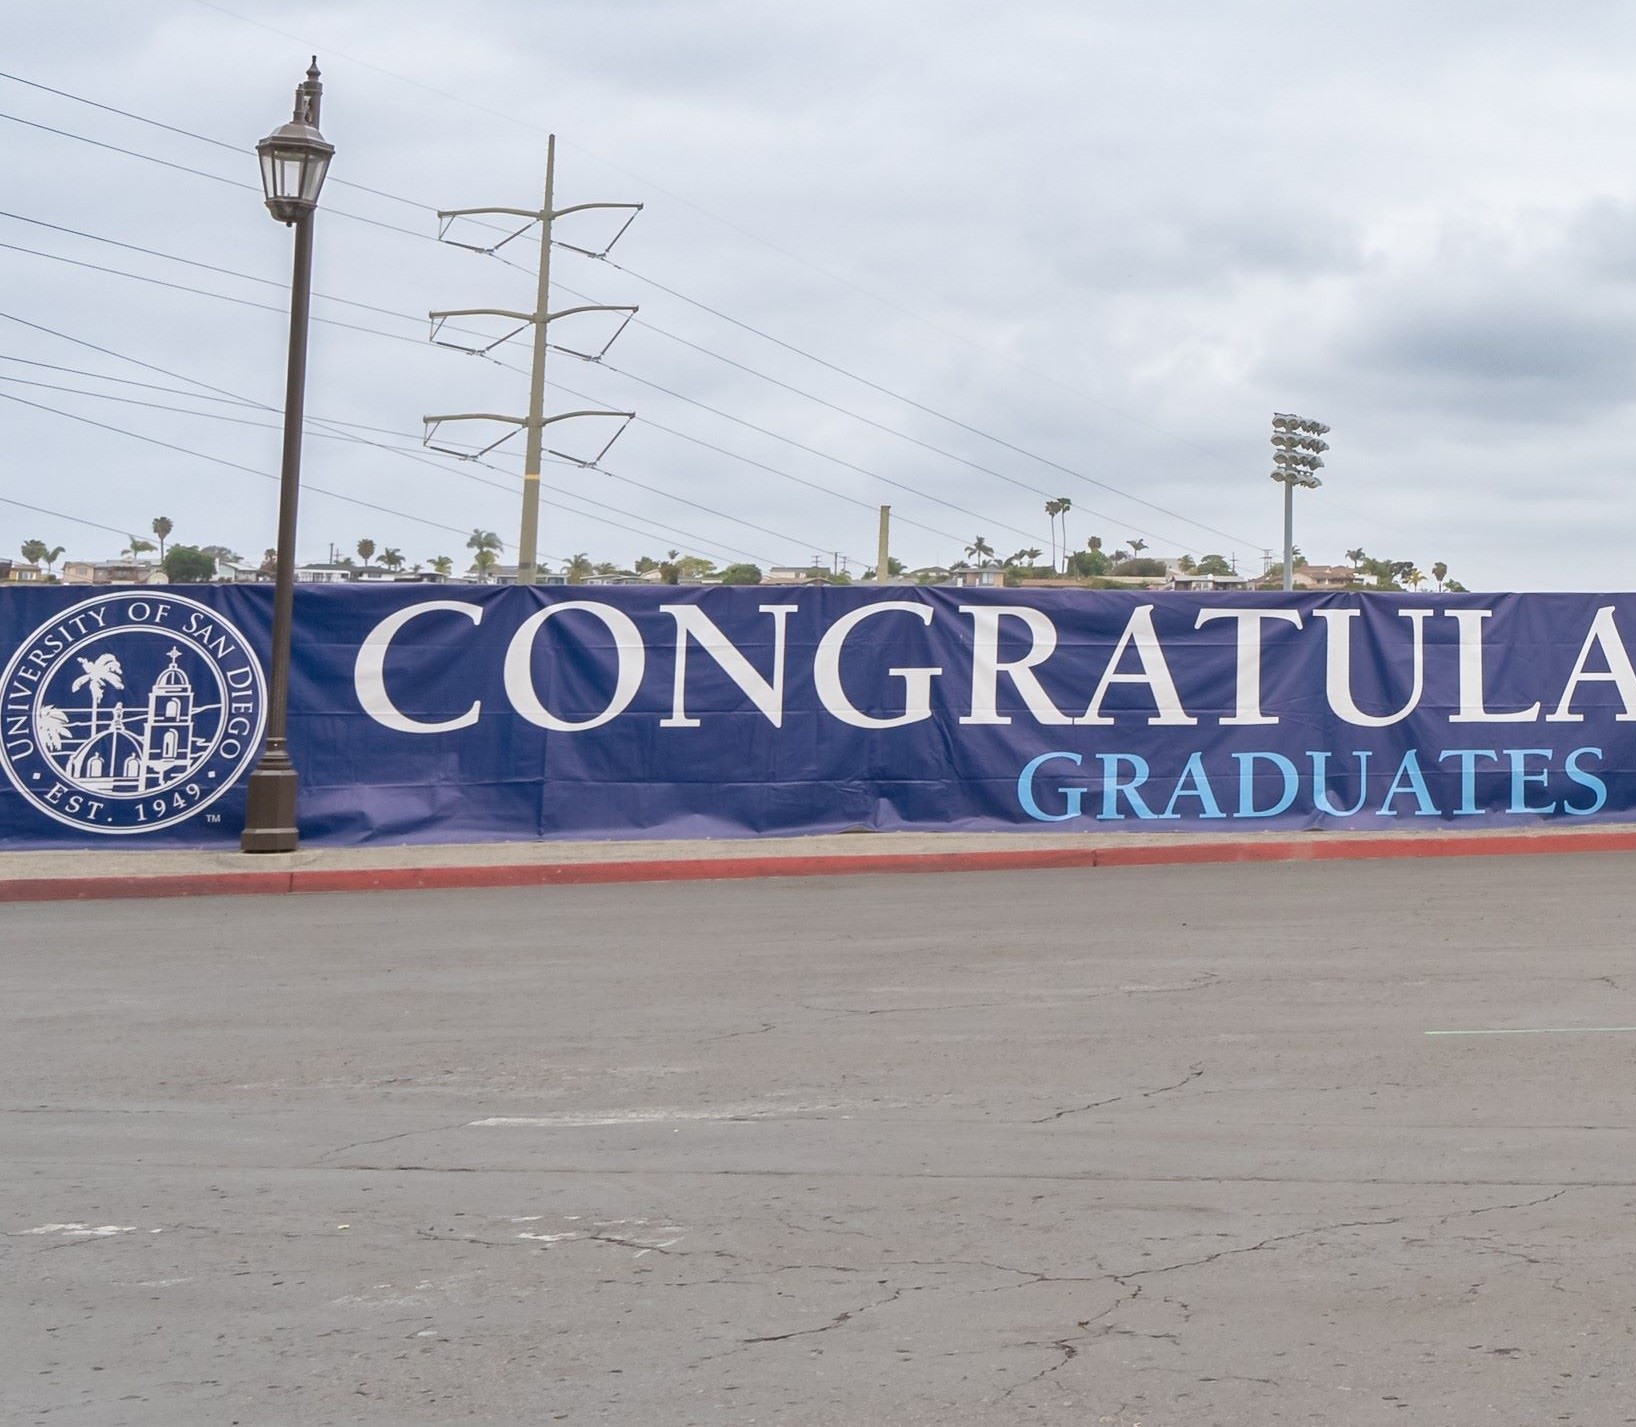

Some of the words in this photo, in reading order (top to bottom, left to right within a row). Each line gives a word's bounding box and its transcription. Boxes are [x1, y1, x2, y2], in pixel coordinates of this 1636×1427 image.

[7, 607, 109, 761] UNIVERSITY
[128, 602, 170, 623] OF
[182, 612, 235, 659] SAN
[220, 666, 254, 760] DIEGO
[44, 781, 113, 822] EST.
[135, 783, 201, 821] 1949
[1017, 748, 1607, 822] GRADUATES
